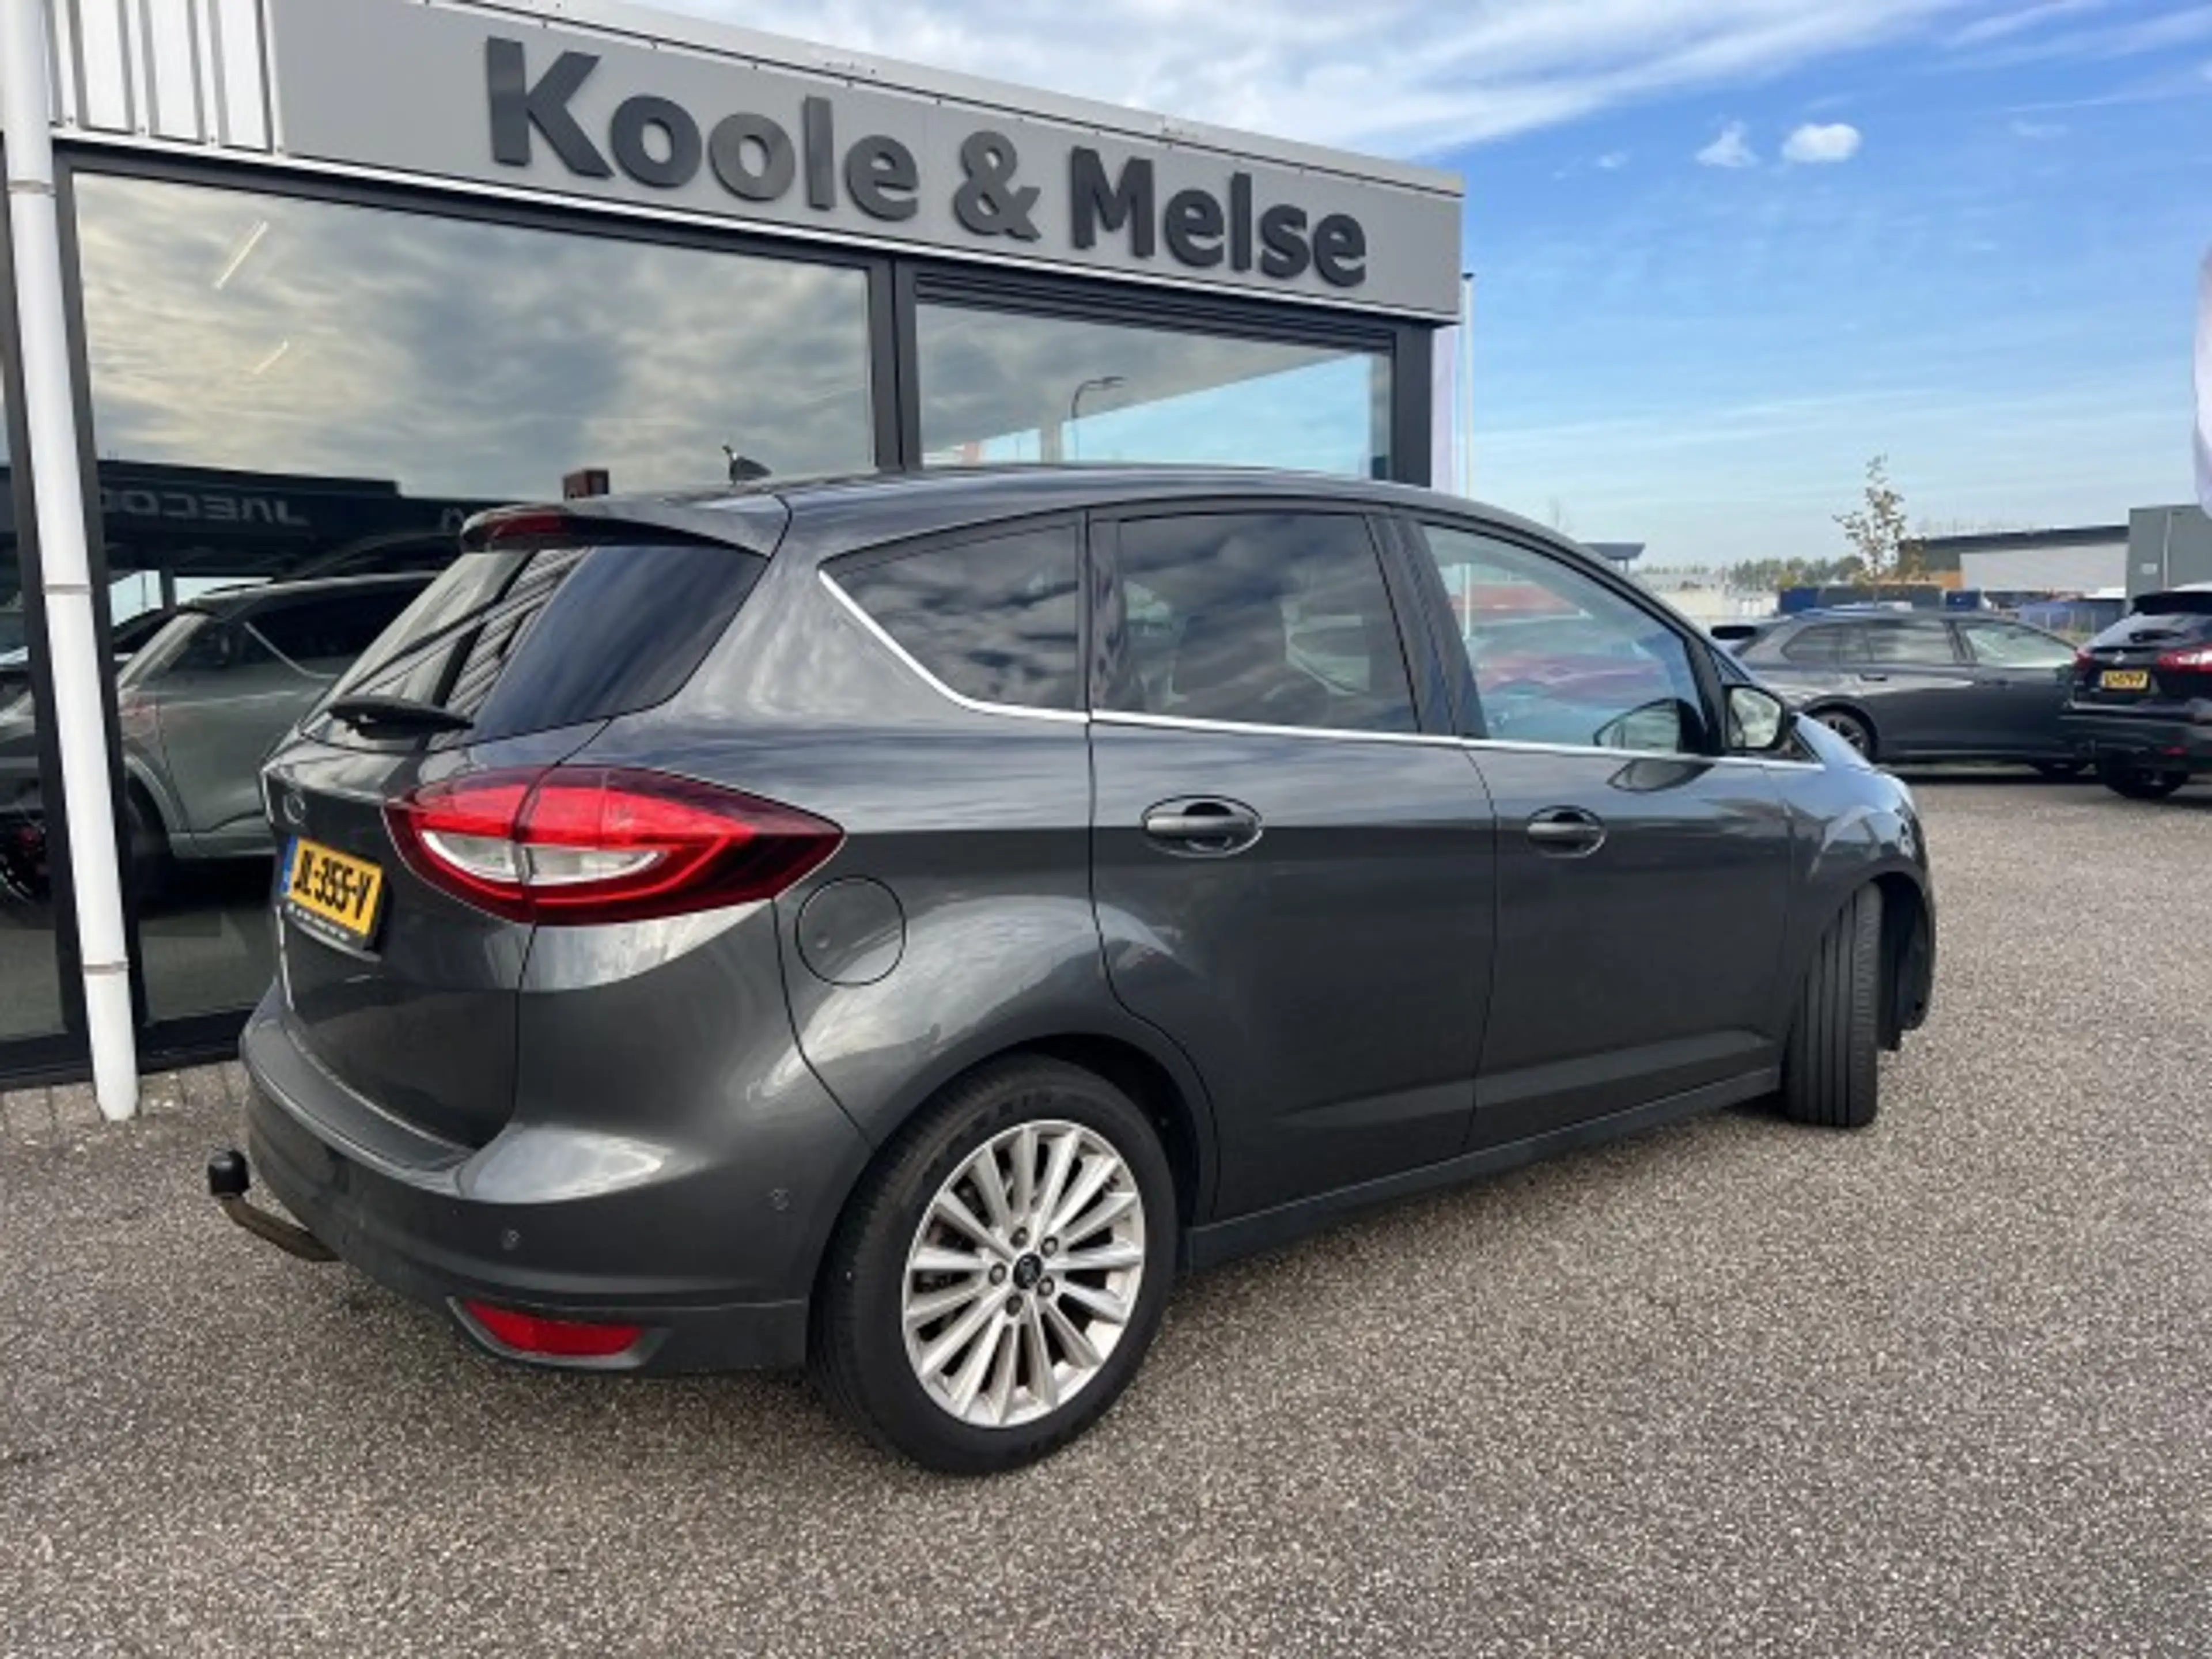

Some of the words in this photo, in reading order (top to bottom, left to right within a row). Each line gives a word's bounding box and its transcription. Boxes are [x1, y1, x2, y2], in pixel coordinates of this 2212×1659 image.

[485, 36, 919, 221] Koole
[953, 130, 1041, 243] &
[1069, 146, 1368, 288] Melse
